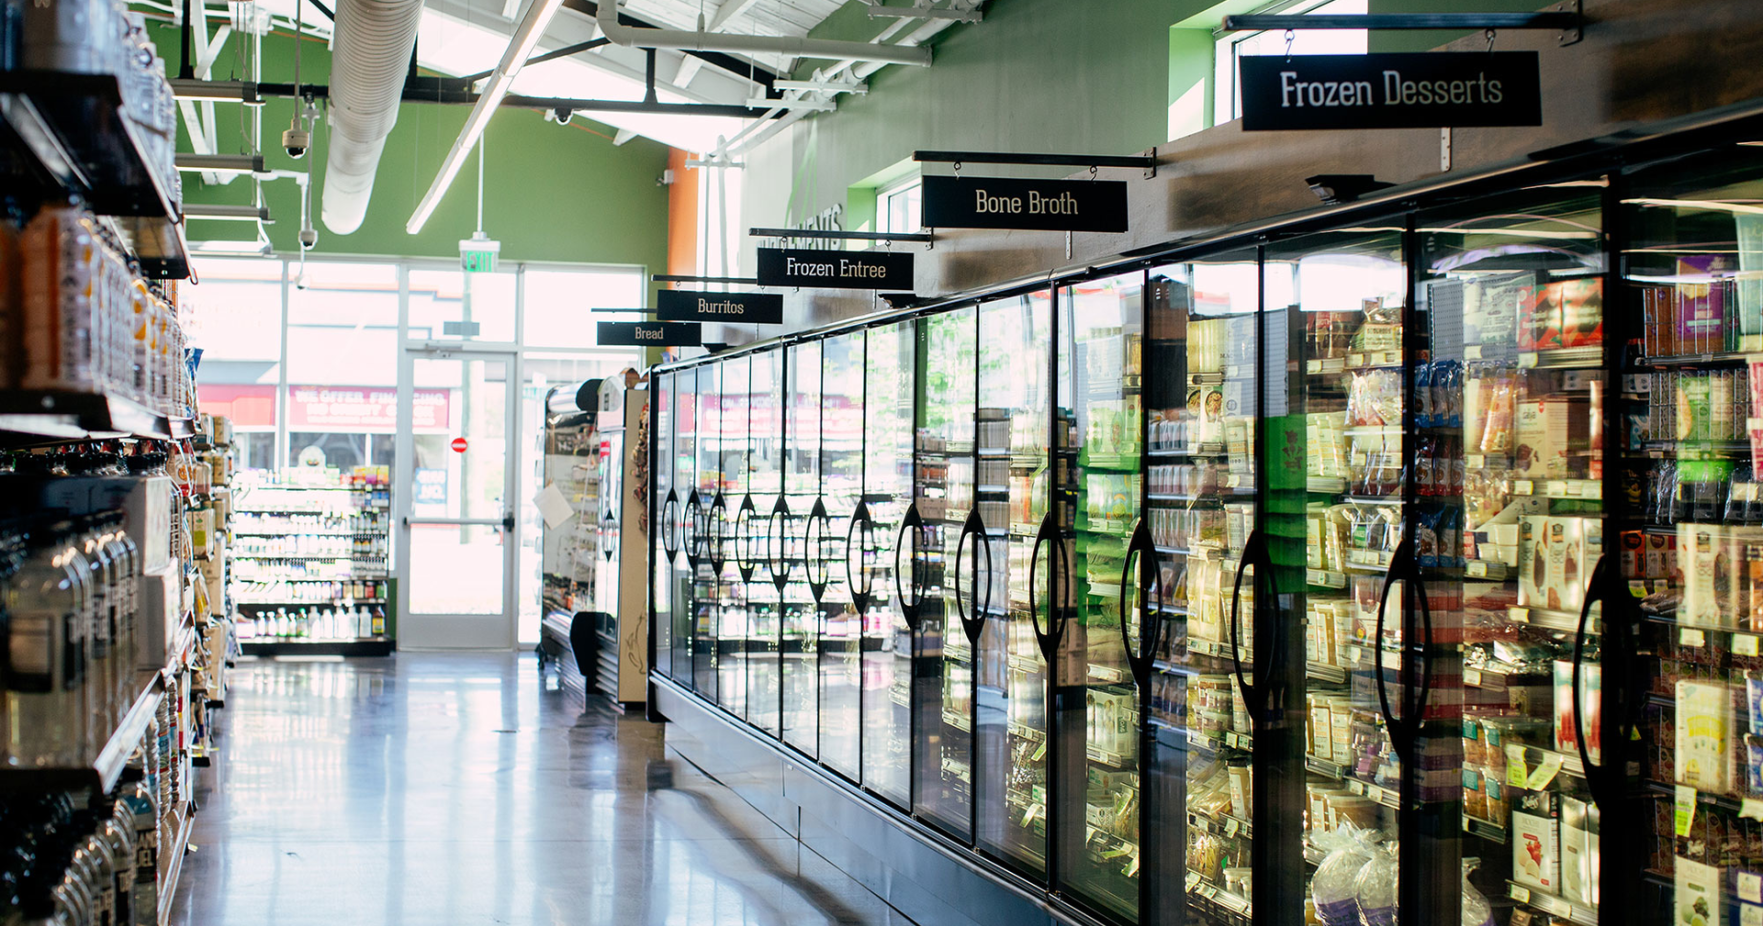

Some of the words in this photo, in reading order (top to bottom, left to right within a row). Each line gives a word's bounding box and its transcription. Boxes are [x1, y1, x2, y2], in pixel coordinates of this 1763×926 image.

[1280, 71, 1373, 107] Frozen
[1382, 70, 1503, 105] Desserts
[975, 189, 1022, 213] Bone
[1028, 190, 1079, 215] Broth
[467, 251, 493, 273] EXIT
[786, 257, 834, 277] Frozen
[839, 259, 887, 279] Entree
[697, 298, 744, 314] Burritos
[635, 326, 664, 340] Bread
[320, 390, 365, 404] OFFER
[370, 391, 446, 407] FINACING
